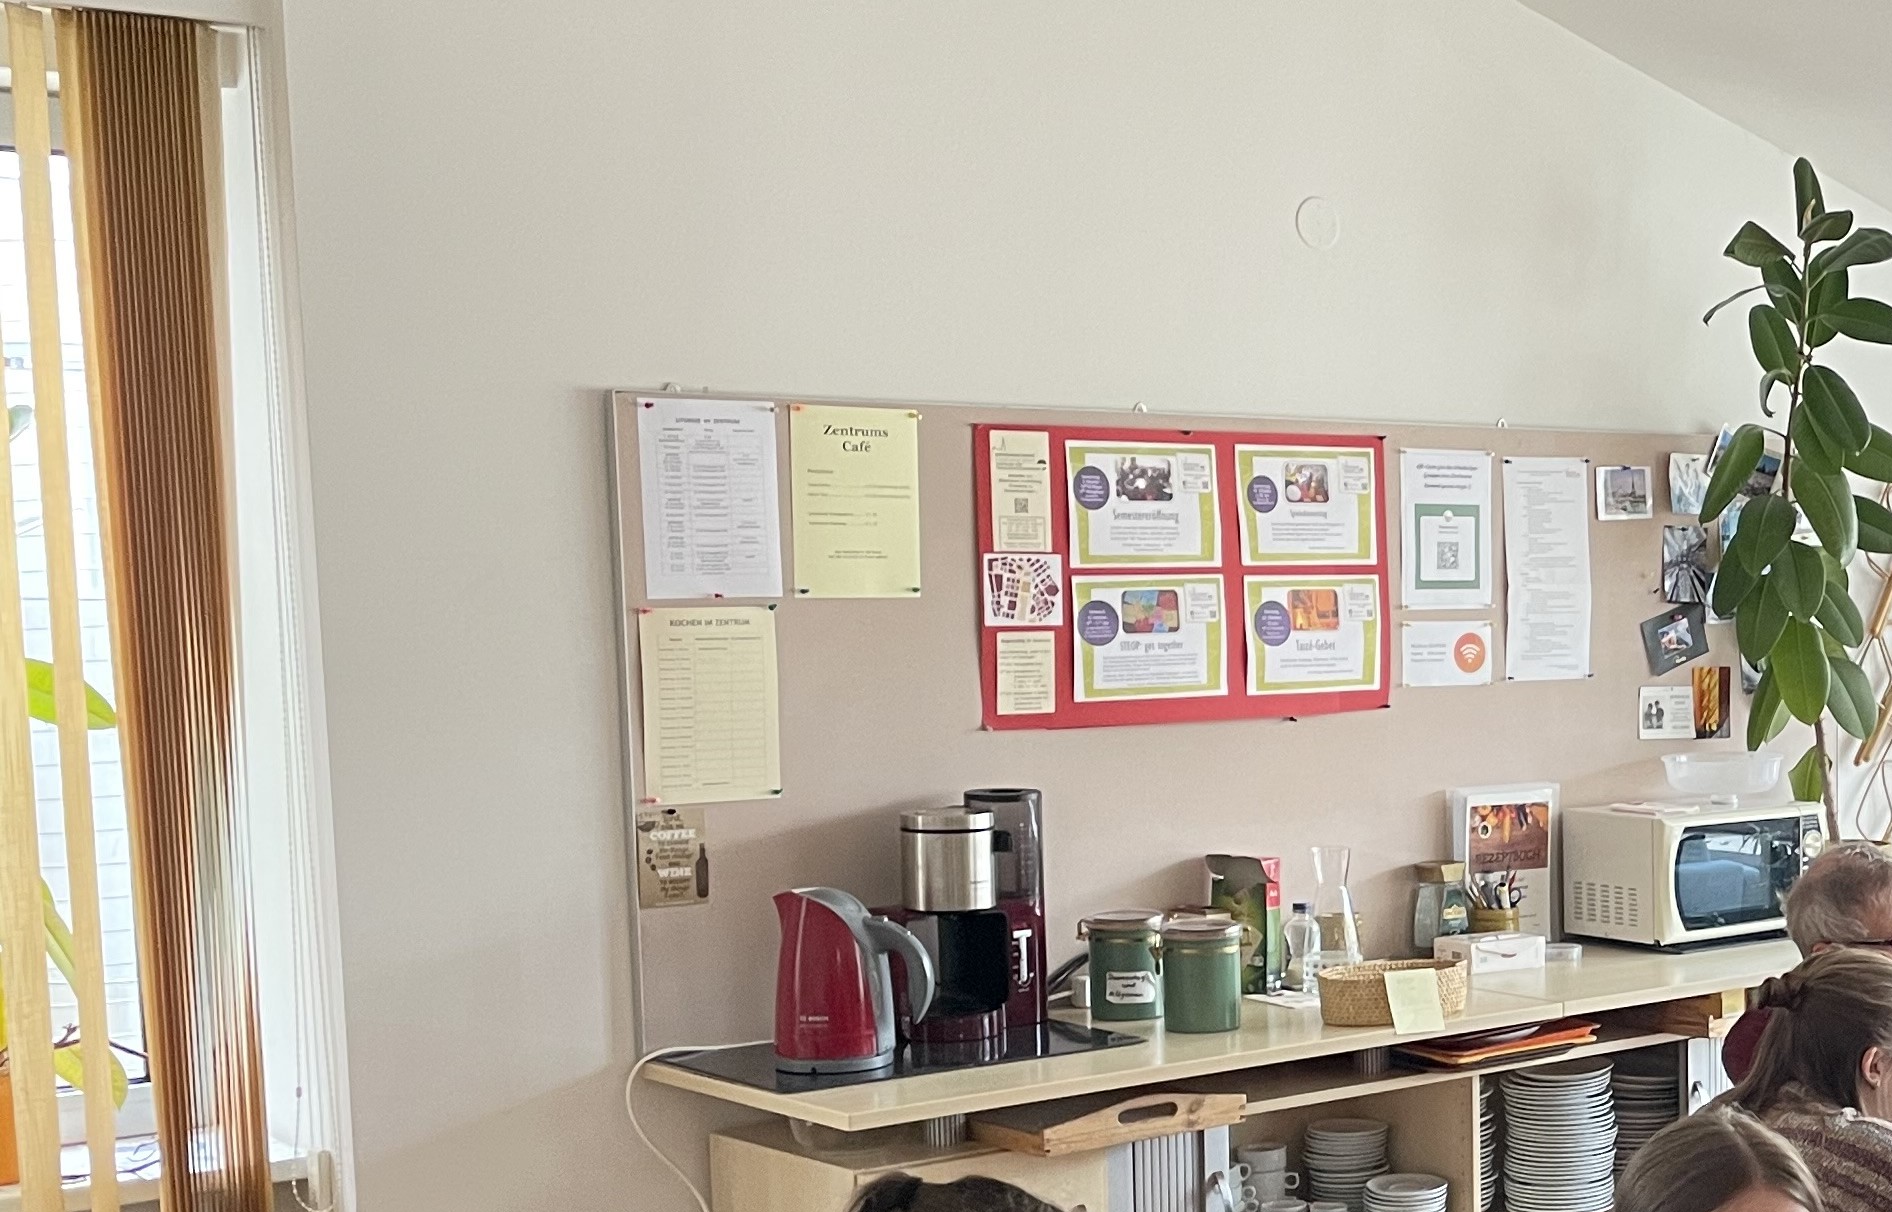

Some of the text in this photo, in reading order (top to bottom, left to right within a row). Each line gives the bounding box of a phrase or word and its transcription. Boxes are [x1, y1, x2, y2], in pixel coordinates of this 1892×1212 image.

[823, 424, 889, 438] Zentrums
[842, 440, 872, 453] Café
[649, 828, 697, 841] COFFEE
